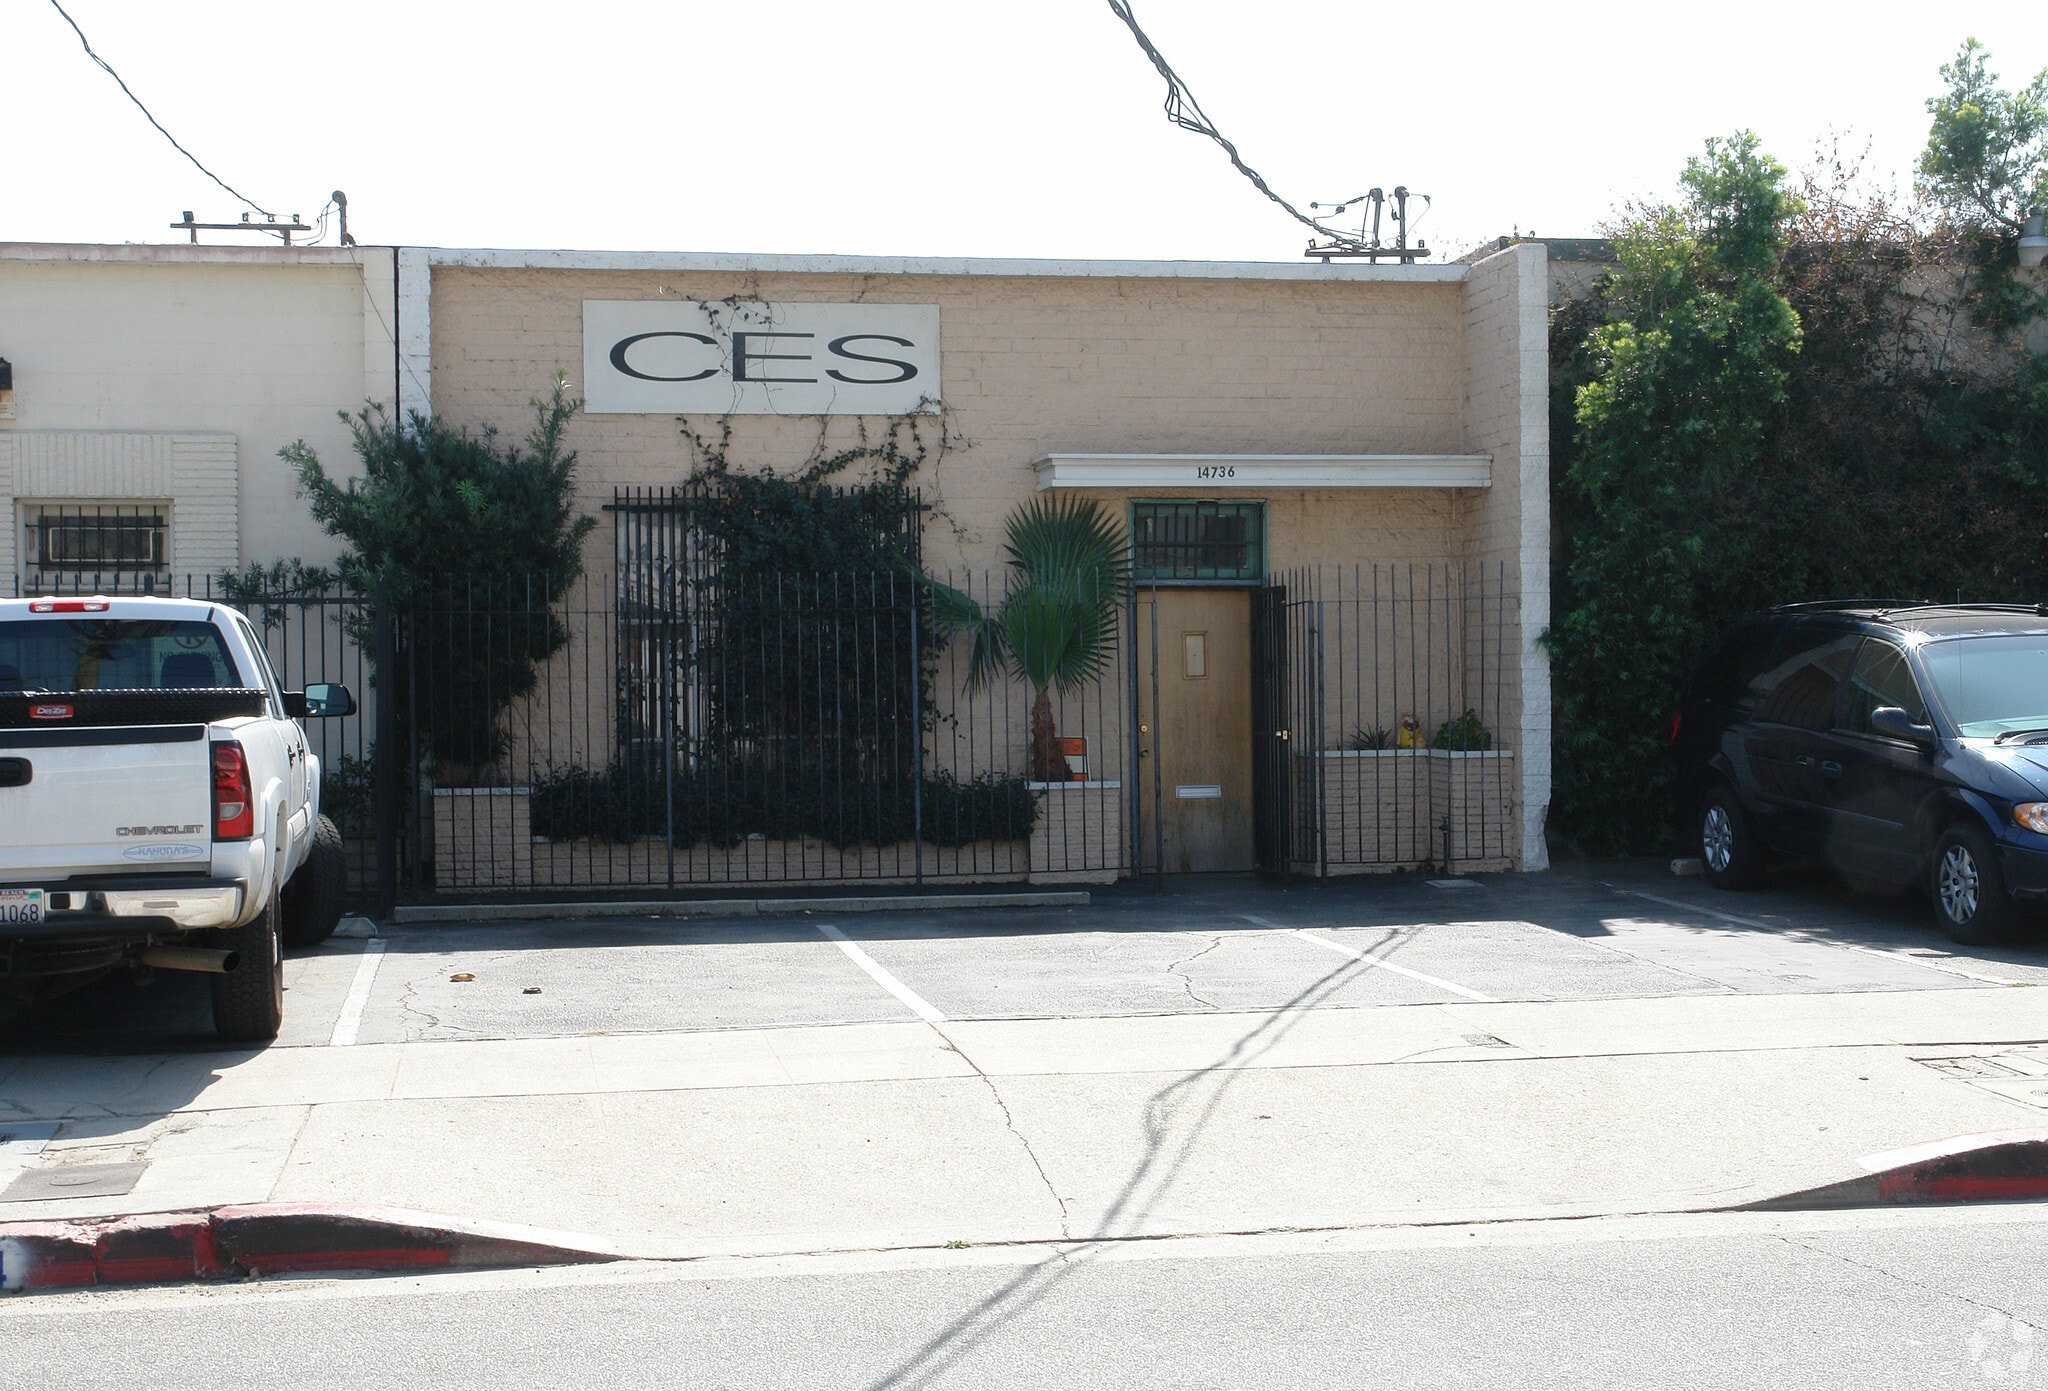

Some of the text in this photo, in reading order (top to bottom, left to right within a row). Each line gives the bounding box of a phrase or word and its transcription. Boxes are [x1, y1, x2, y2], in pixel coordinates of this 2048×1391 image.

[609, 331, 918, 384] CES
[1197, 465, 1235, 479] 14736
[116, 824, 204, 837] CHEVROLET
